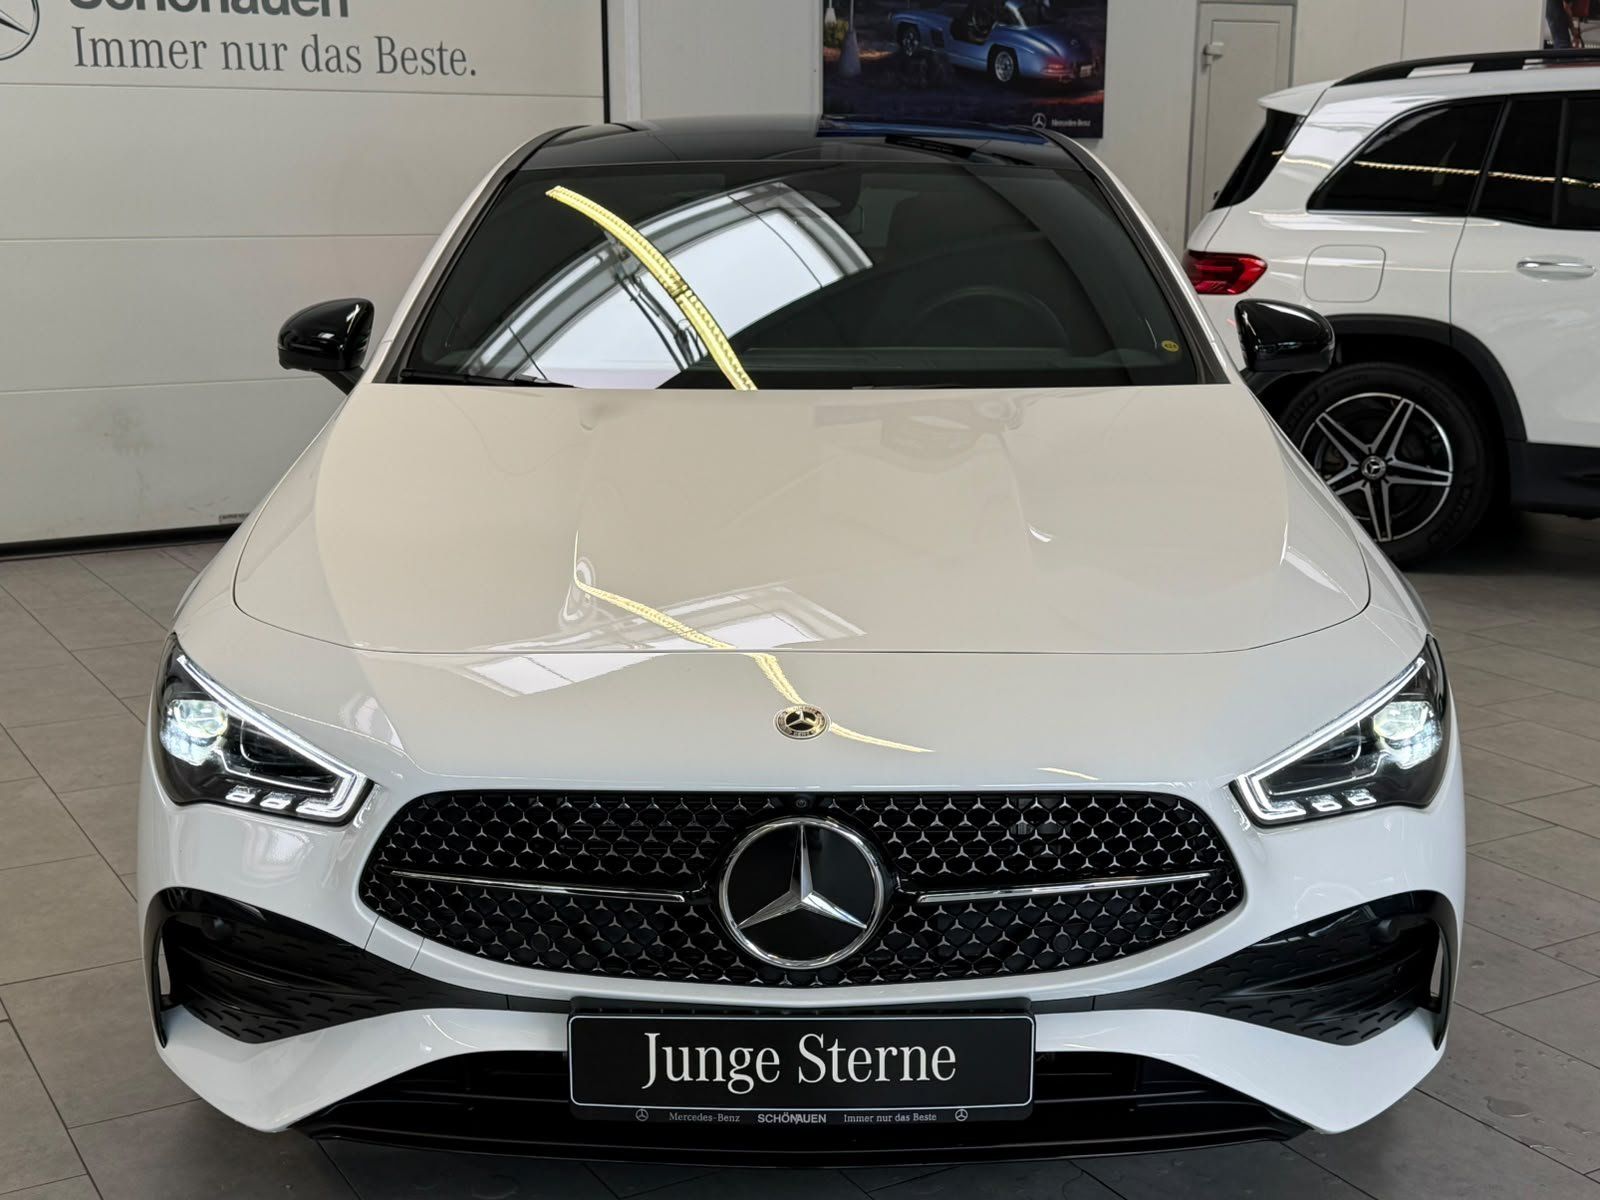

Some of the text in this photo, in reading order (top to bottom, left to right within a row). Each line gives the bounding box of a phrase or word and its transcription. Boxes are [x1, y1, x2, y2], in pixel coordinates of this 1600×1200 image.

[71, 26, 477, 77] Immer nur das Beste.
[641, 1032, 956, 1095] Junge Sterne
[669, 1112, 740, 1122] Mercedes-Benz
[757, 1112, 827, 1125] SCHÖNAUEN
[843, 1114, 874, 1123] Immer
[895, 1113, 910, 1122] das
[913, 1112, 937, 1121] Beste
